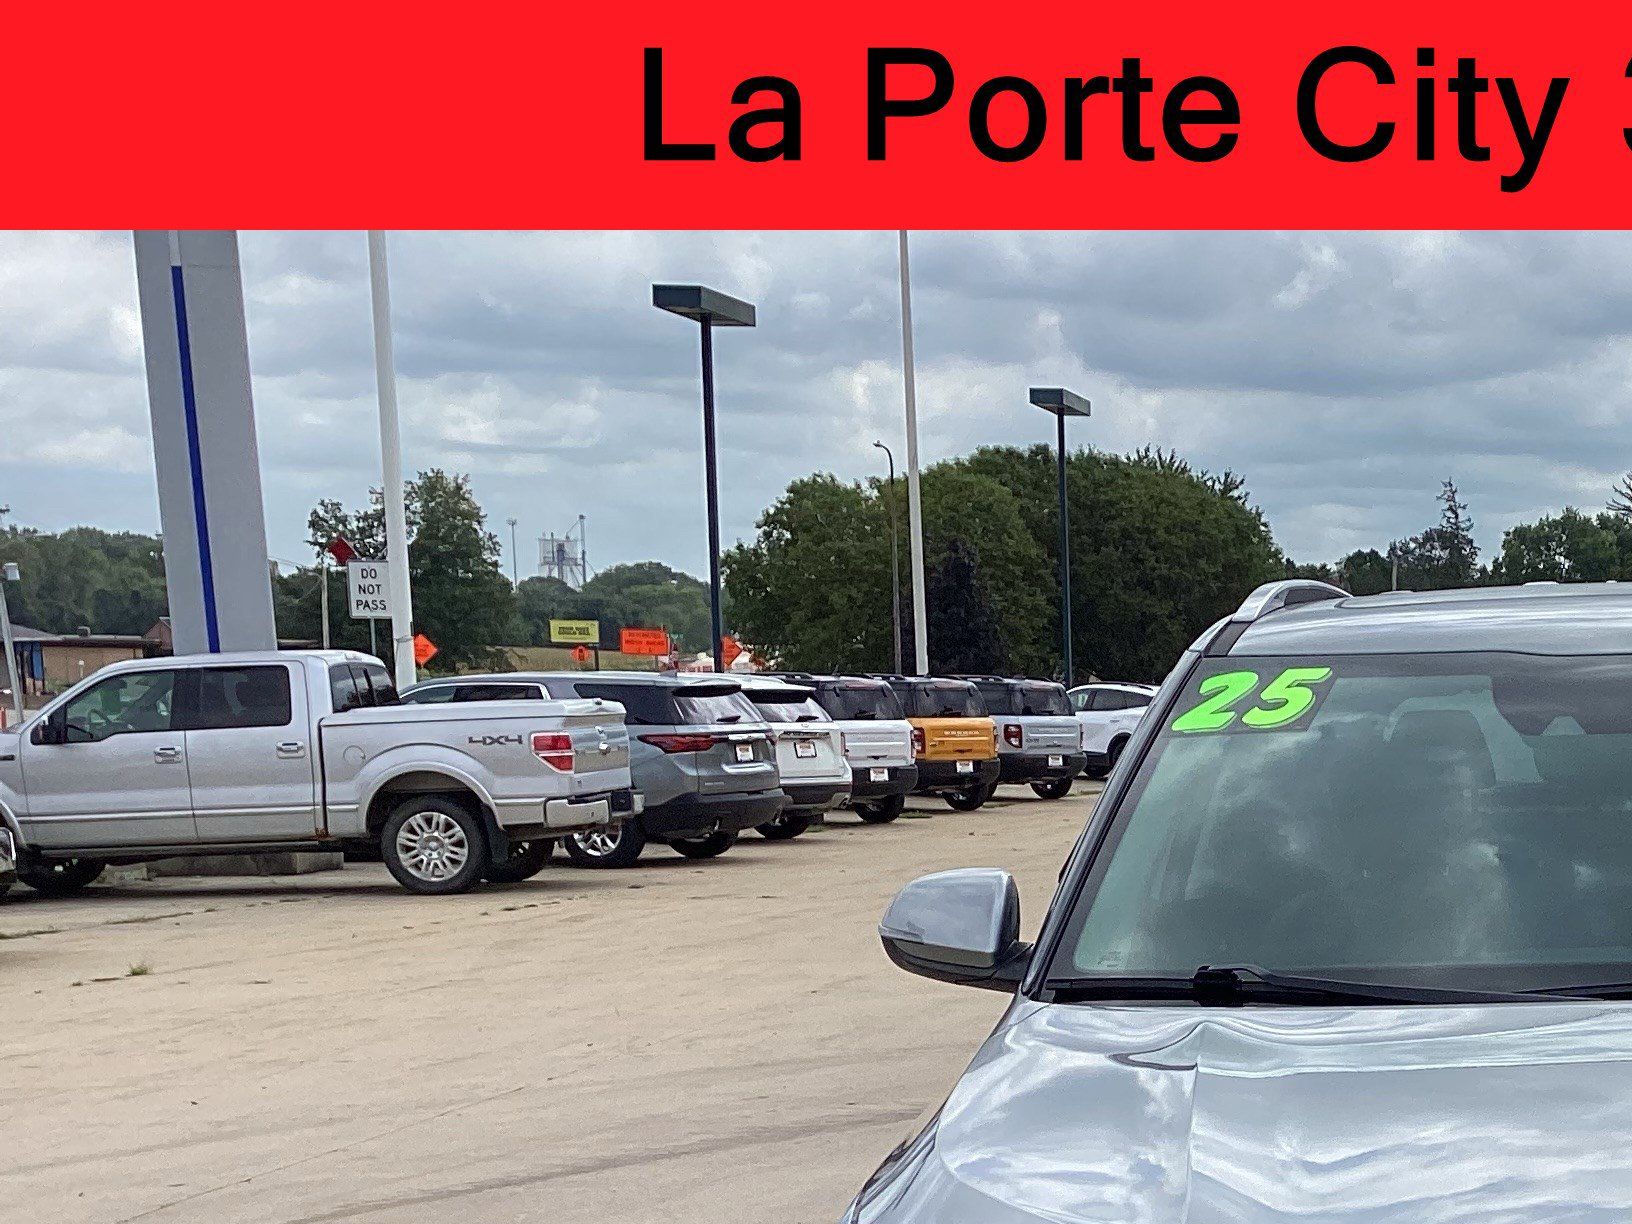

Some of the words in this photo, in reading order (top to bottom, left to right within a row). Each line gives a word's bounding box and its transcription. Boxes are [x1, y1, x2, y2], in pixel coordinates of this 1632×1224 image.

[361, 568, 377, 579] DO
[358, 584, 381, 594] NOT
[356, 600, 387, 611] PASS
[1171, 667, 1333, 733] 25
